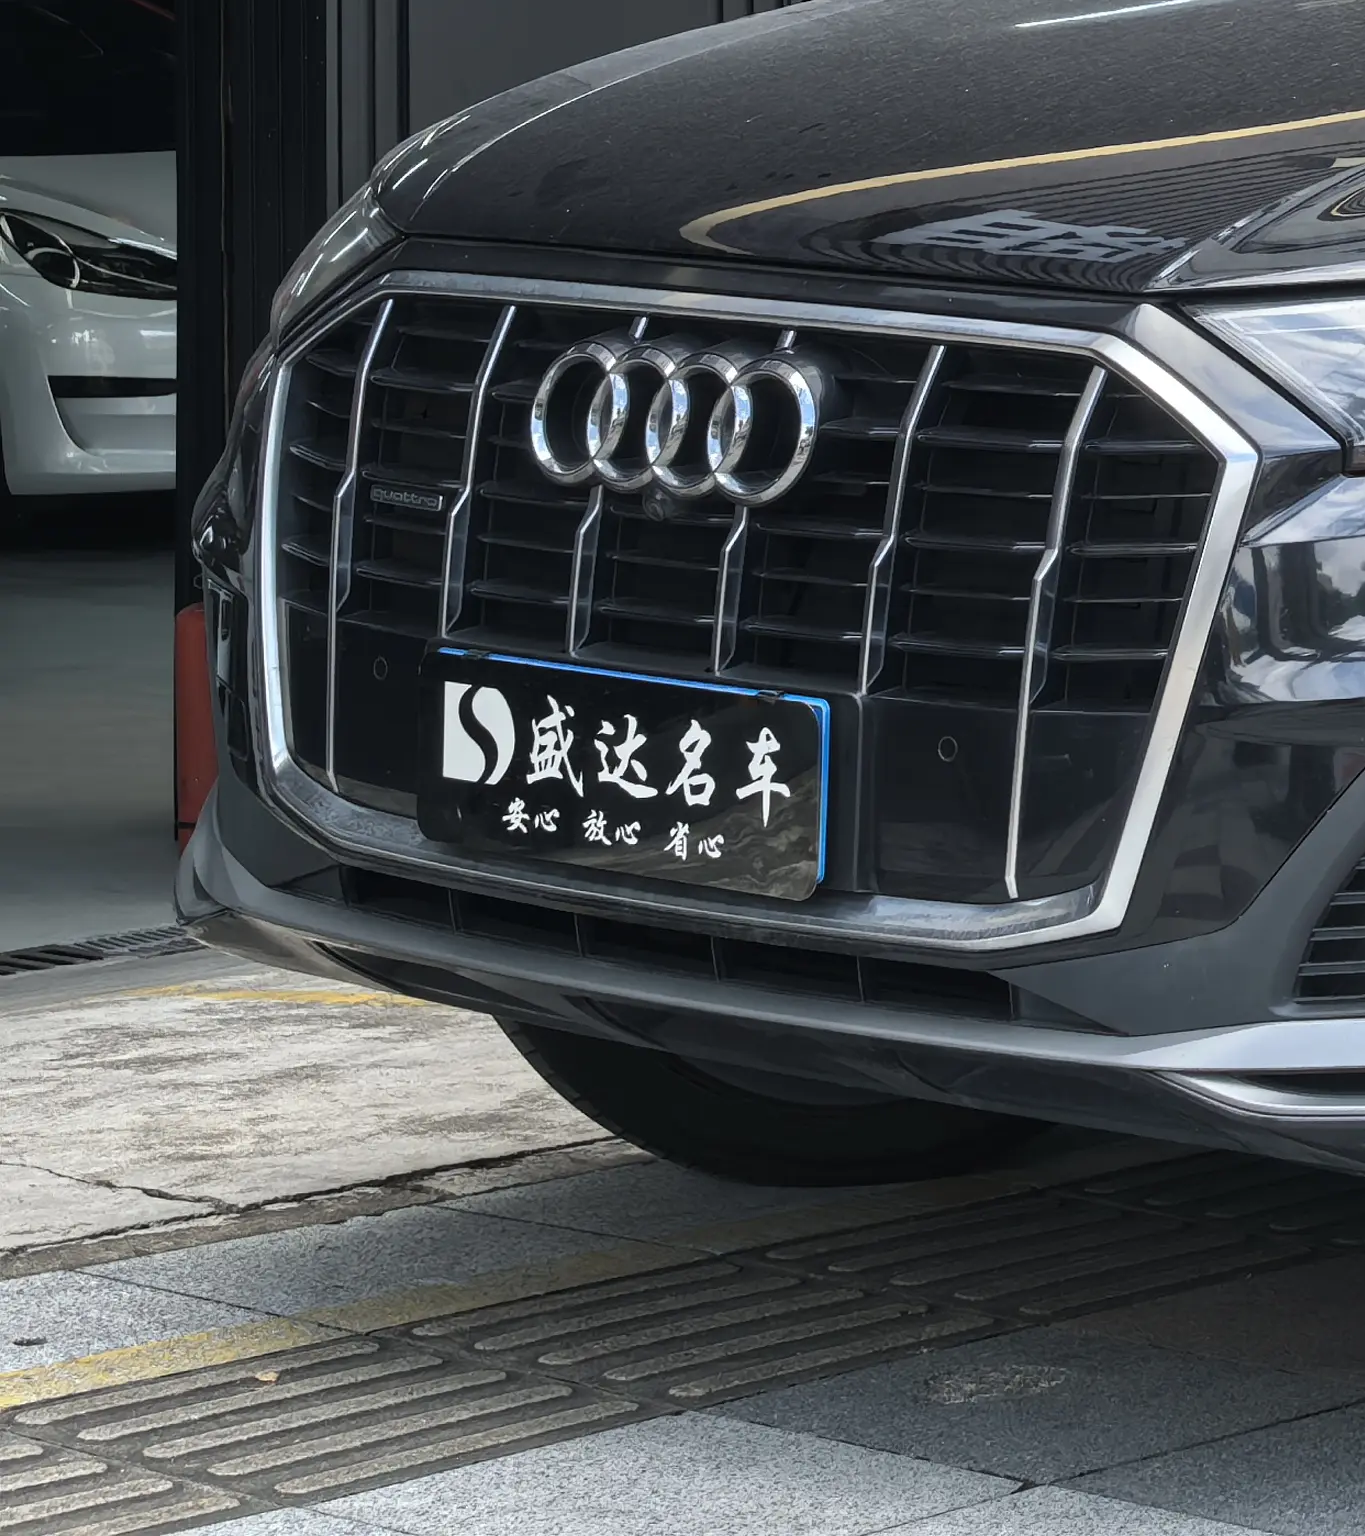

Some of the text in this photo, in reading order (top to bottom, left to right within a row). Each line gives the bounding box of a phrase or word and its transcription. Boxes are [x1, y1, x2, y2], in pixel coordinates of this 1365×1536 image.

[526, 695, 791, 828] 盛达名车
[502, 797, 726, 862] 安心 放心 省心
